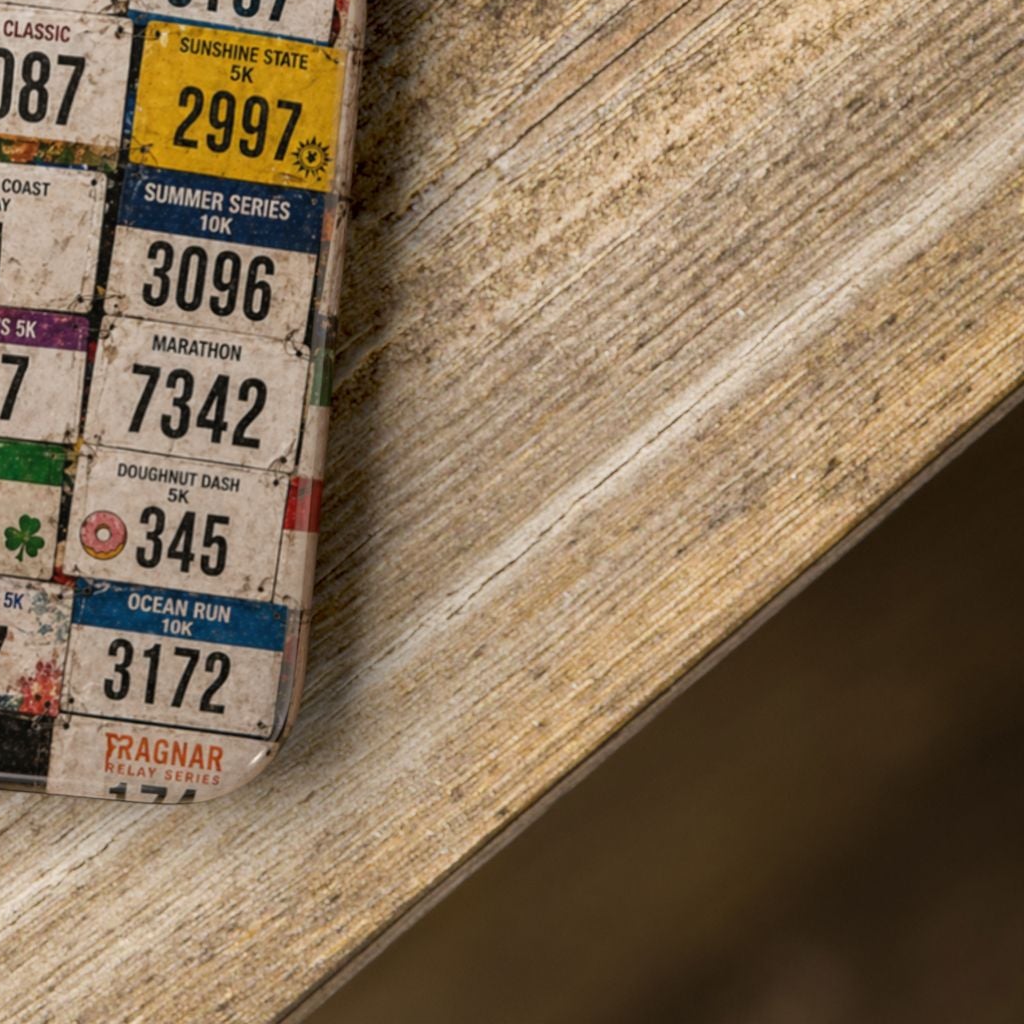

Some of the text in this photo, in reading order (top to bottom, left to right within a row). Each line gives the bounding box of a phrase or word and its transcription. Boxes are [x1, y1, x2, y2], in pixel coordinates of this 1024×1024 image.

[3, 20, 71, 43] CLASSIC
[179, 36, 309, 70] SUNSHINE STATE
[229, 64, 254, 84] 5K
[172, 85, 303, 162] 2997
[1, 178, 51, 197] COAST
[144, 182, 291, 221] SUMMER SERIES
[199, 214, 233, 235] 10K
[142, 240, 275, 322] 3096
[15, 319, 37, 339] 5K
[152, 334, 242, 362] MARATHON
[127, 363, 268, 449] 7342
[117, 462, 241, 493] DOUGHNUT DASH
[167, 488, 189, 504] 5K
[135, 505, 230, 577] 345
[3, 592, 25, 610] 5K
[127, 592, 232, 624] OCEAN RUN
[161, 618, 194, 637] 10K
[103, 638, 231, 715] 3172
[105, 732, 224, 772] RAGNAR
[105, 762, 221, 786] RELAY SERIES
